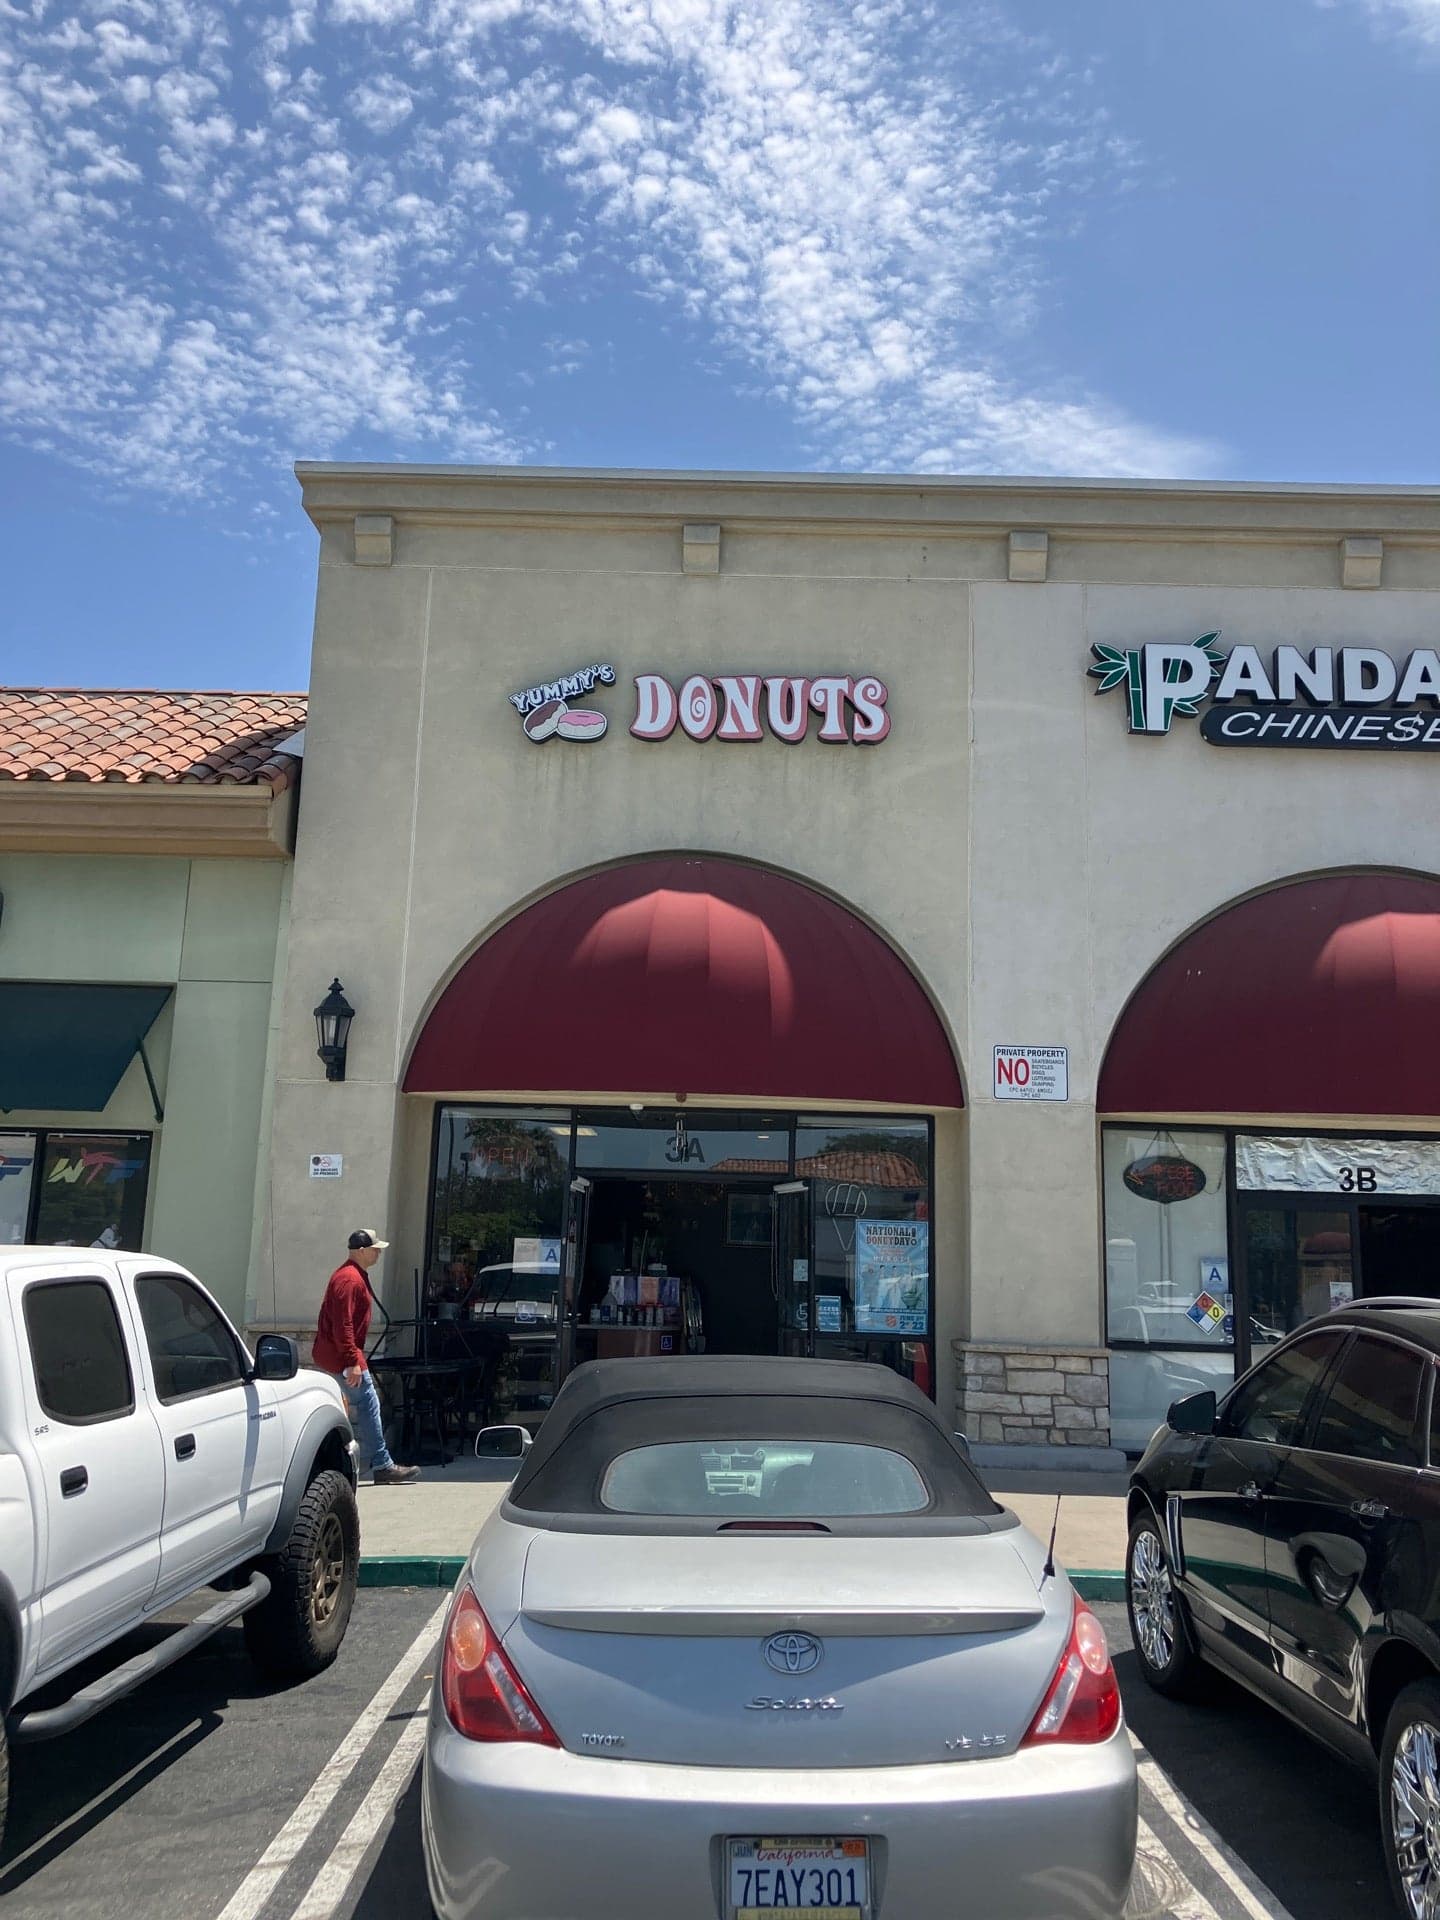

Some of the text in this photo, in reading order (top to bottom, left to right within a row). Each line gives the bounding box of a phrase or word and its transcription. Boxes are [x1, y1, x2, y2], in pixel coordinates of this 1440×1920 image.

[508, 664, 615, 713] YUMMY'S
[1144, 643, 1440, 733] PANDA
[630, 674, 891, 745] DONUTS
[997, 1048, 1065, 1057] PRIVATE PROPERTY
[998, 1058, 1030, 1085] NO
[665, 1136, 705, 1163] 3A
[1339, 1166, 1378, 1192] 3B
[866, 1226, 911, 1237] NATIONAL
[545, 1247, 558, 1262] A
[1209, 1267, 1222, 1281] A
[744, 1696, 844, 1710] Solara
[757, 1848, 835, 1866] California
[737, 1867, 861, 1907] 7EAY301
